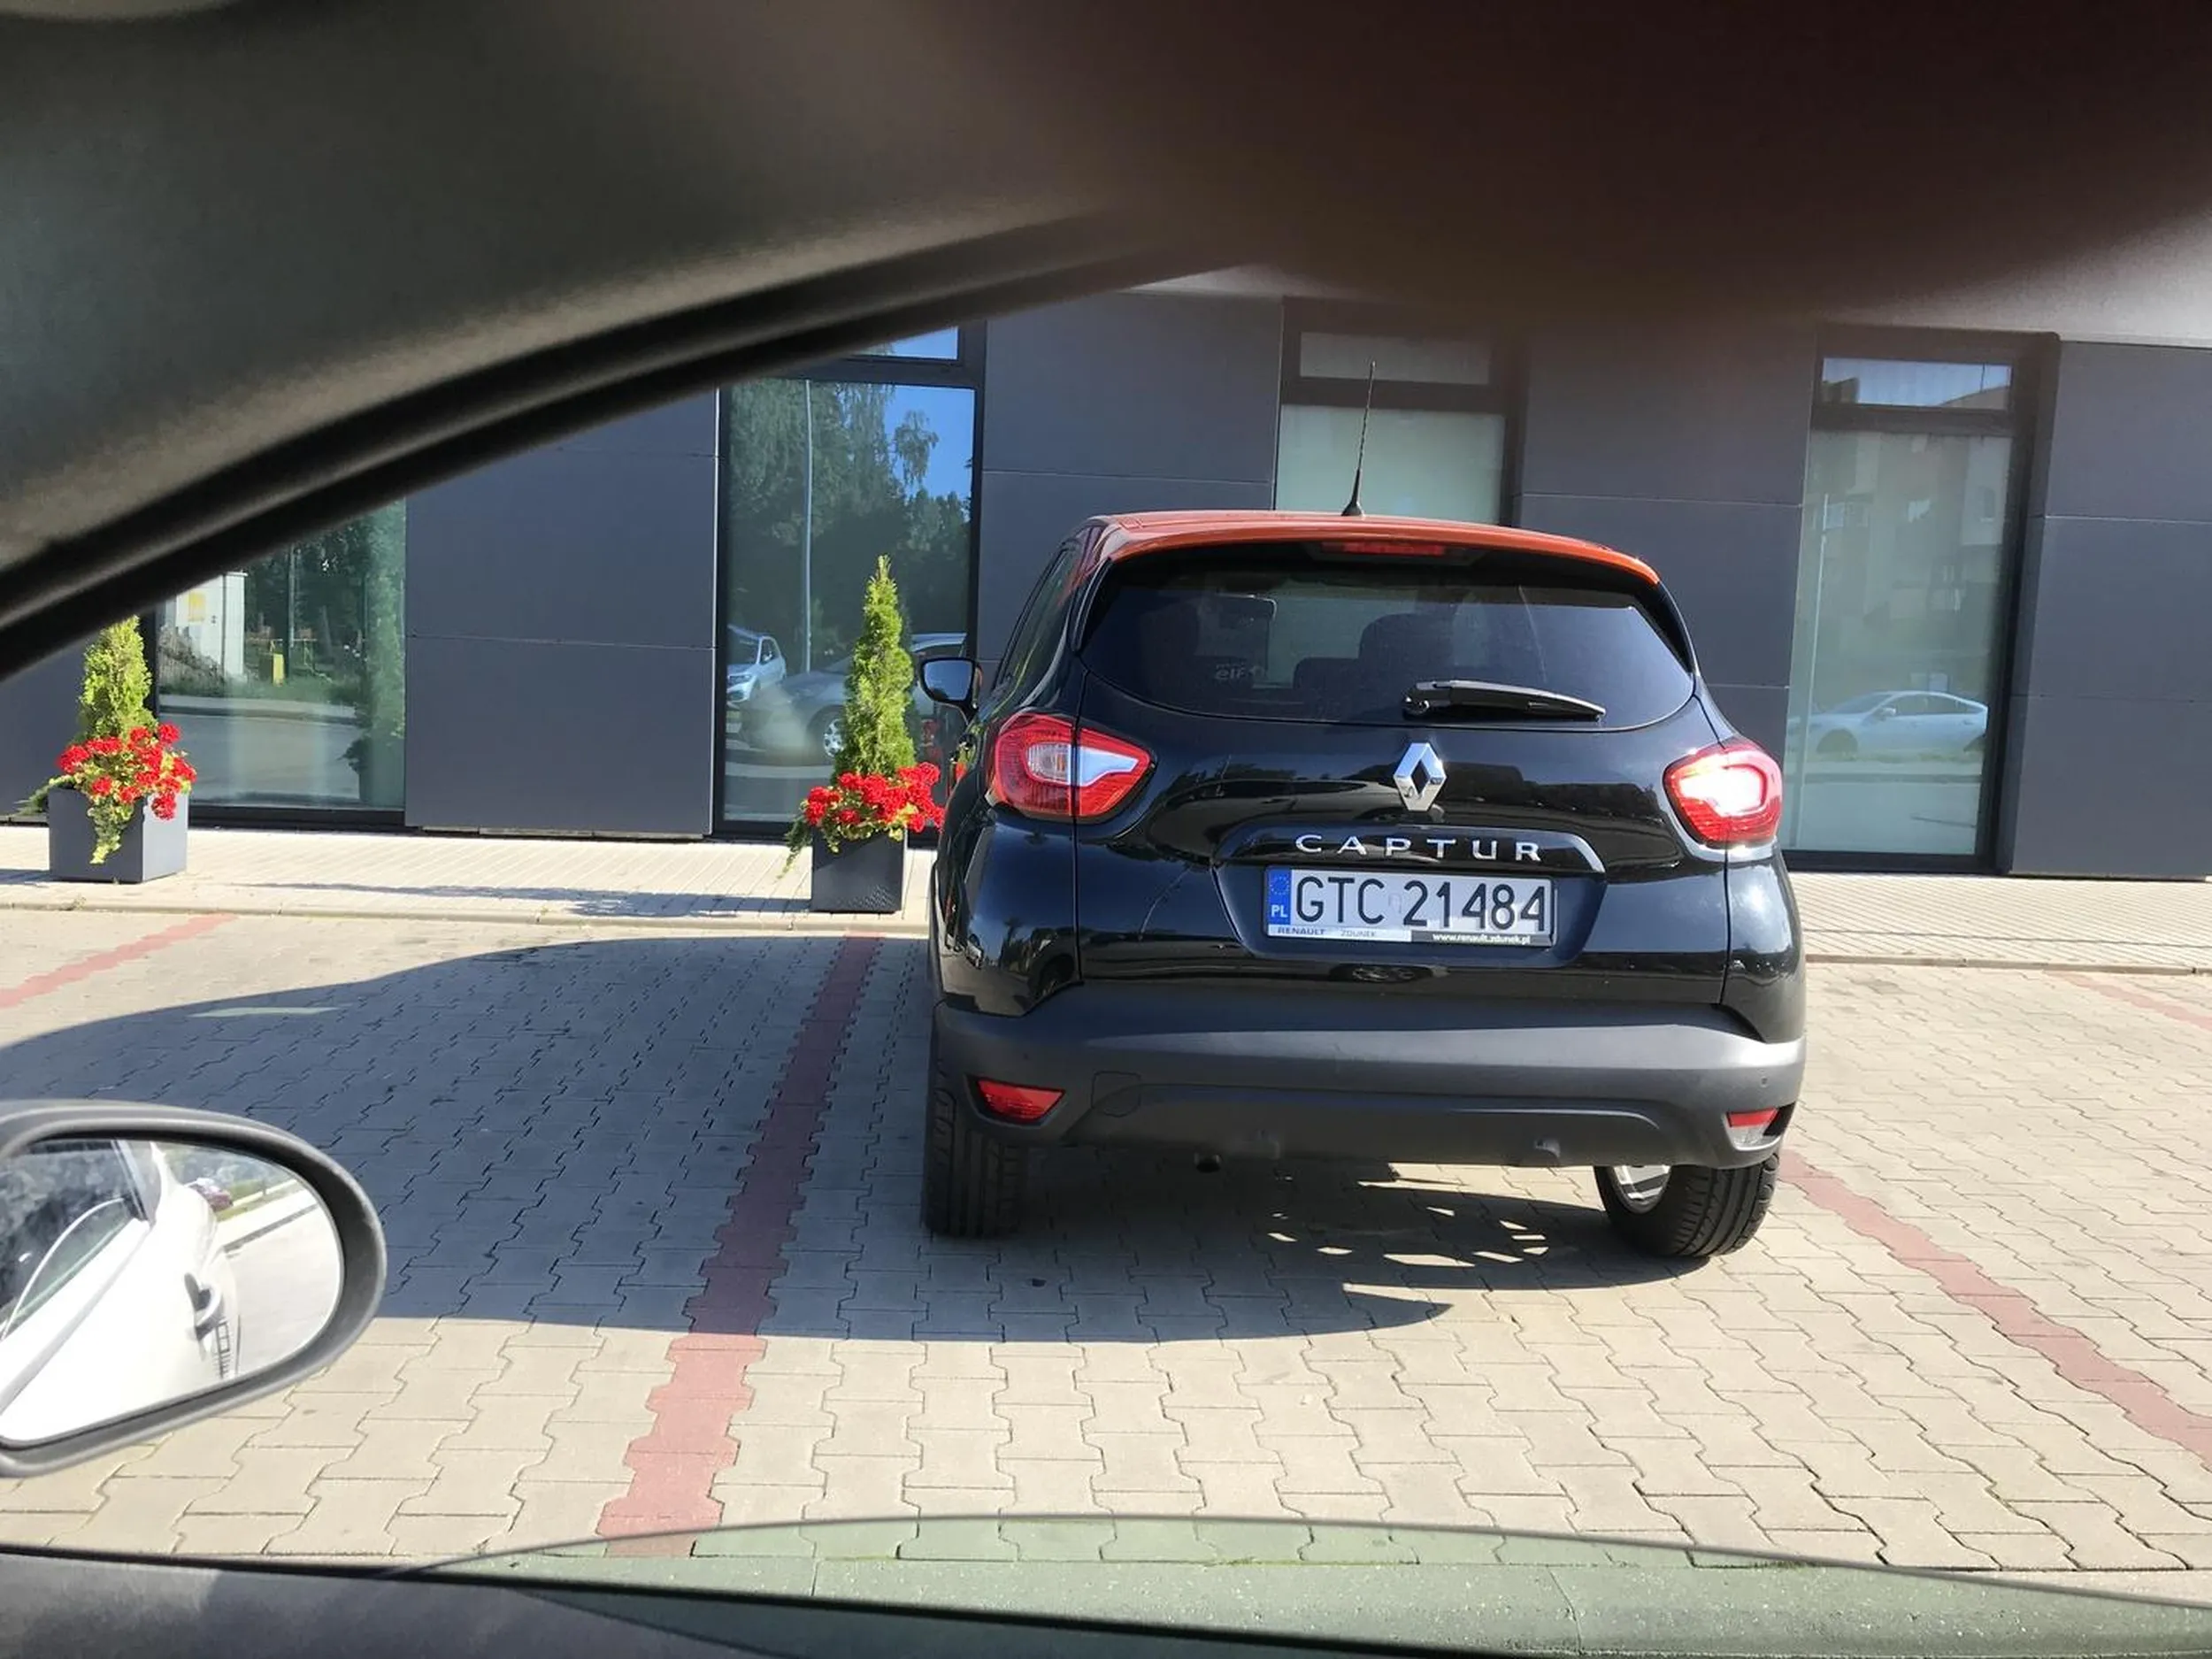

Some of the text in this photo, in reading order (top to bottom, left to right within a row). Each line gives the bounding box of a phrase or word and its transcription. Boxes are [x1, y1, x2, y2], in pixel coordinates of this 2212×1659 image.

[1295, 834, 1541, 861] CAPTUR
[1271, 904, 1288, 918] PL
[1296, 876, 1545, 932] GTC 21484
[1277, 926, 1325, 936] RENAULT
